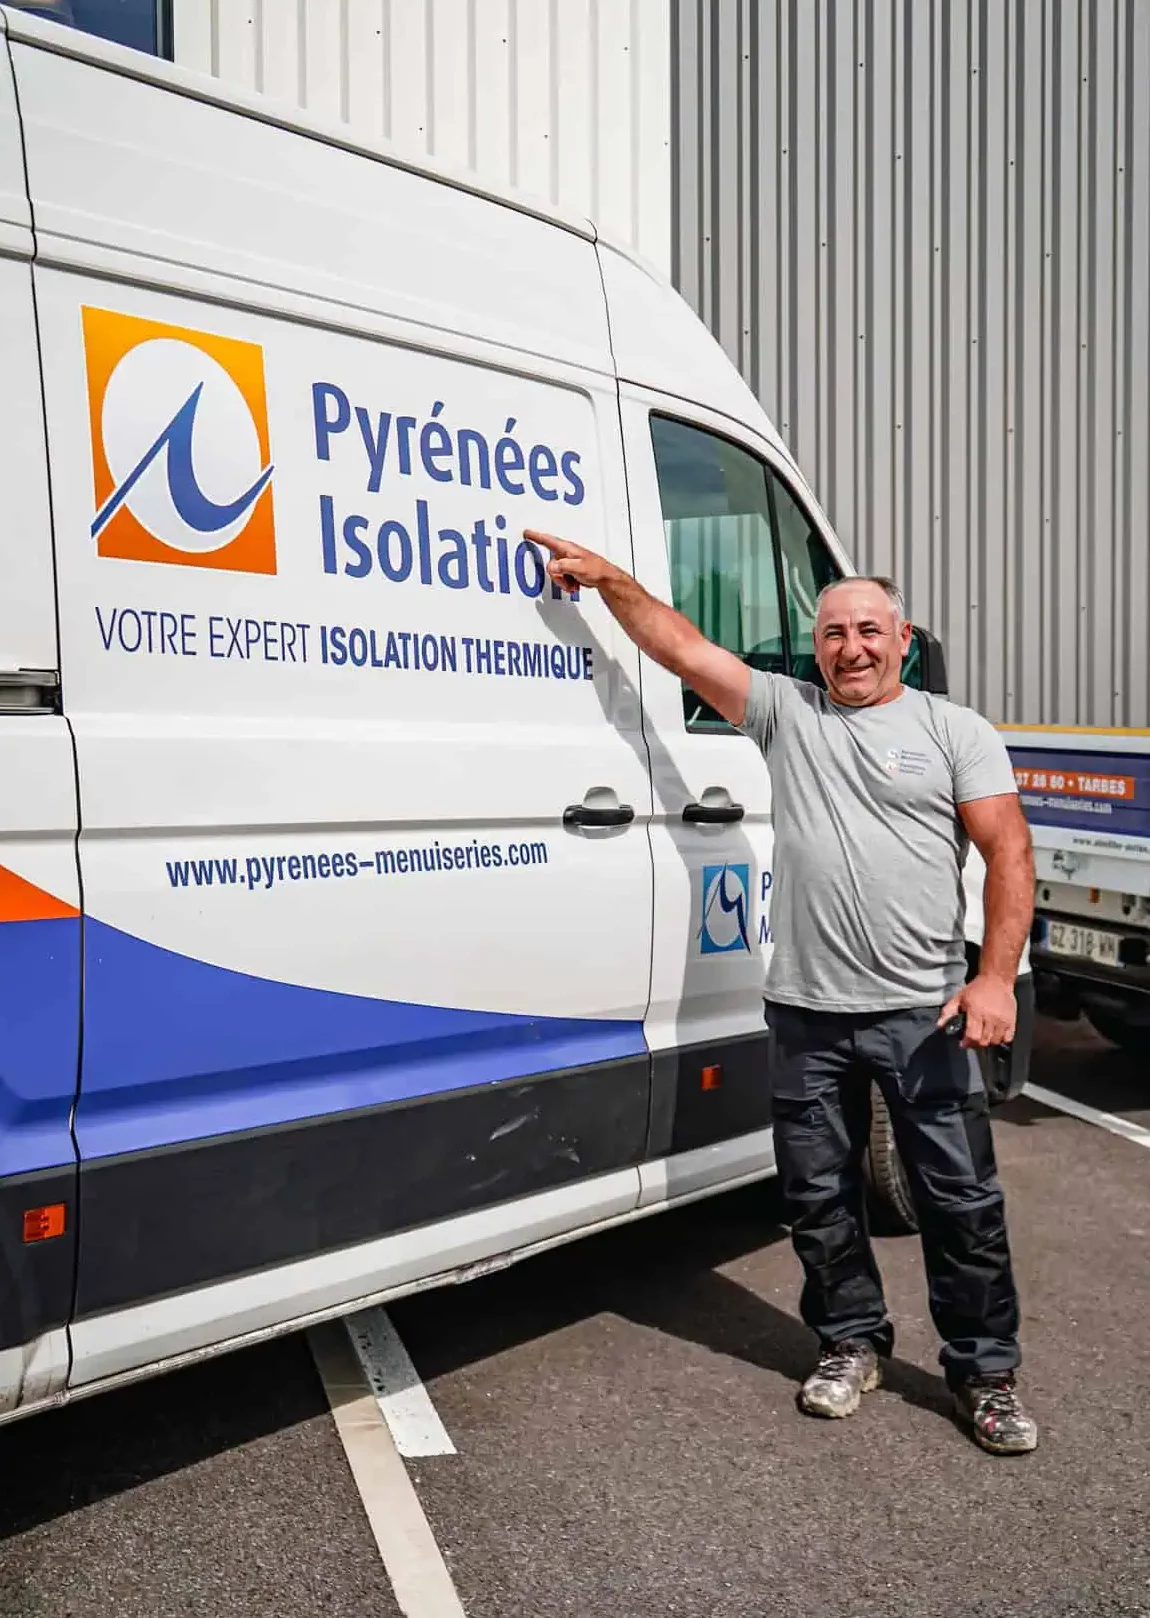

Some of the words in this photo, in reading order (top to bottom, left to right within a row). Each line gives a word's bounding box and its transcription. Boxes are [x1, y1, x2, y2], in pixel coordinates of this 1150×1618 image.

[312, 382, 585, 506] Pyrénées
[95, 606, 197, 655] VOTRE
[209, 616, 310, 663] EXPERT
[320, 625, 457, 672] ISOLATION
[461, 637, 594, 681] THERMIQUE
[1077, 775, 1127, 797] TARBES
[165, 839, 549, 890] www.pyrenees-menuiseries.com
